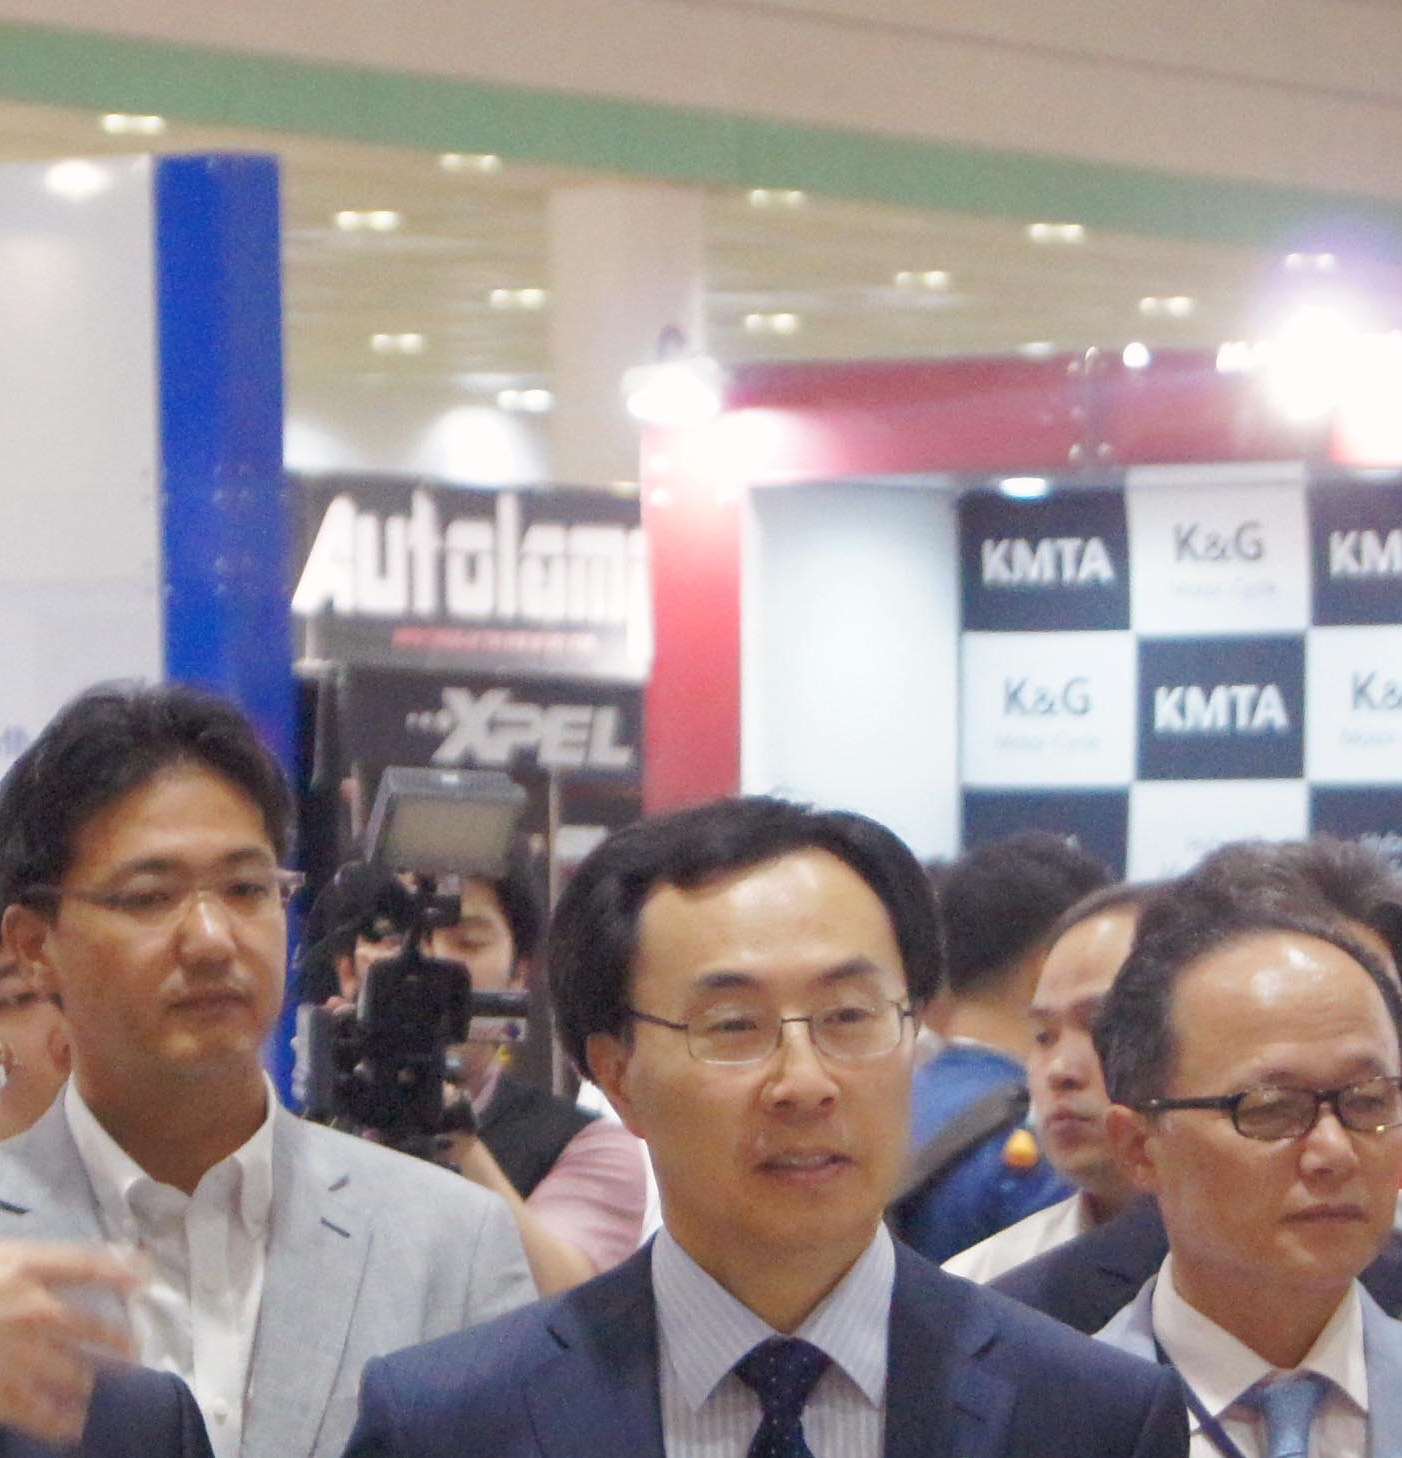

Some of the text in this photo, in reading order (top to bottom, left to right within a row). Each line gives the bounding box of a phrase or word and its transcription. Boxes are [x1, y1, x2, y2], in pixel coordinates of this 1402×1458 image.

[981, 536, 1115, 588] KMTA
[1172, 520, 1266, 563] K&G
[1001, 676, 1092, 718] K&G
[1153, 683, 1291, 738] KMTA
[429, 685, 633, 768] XPEL
